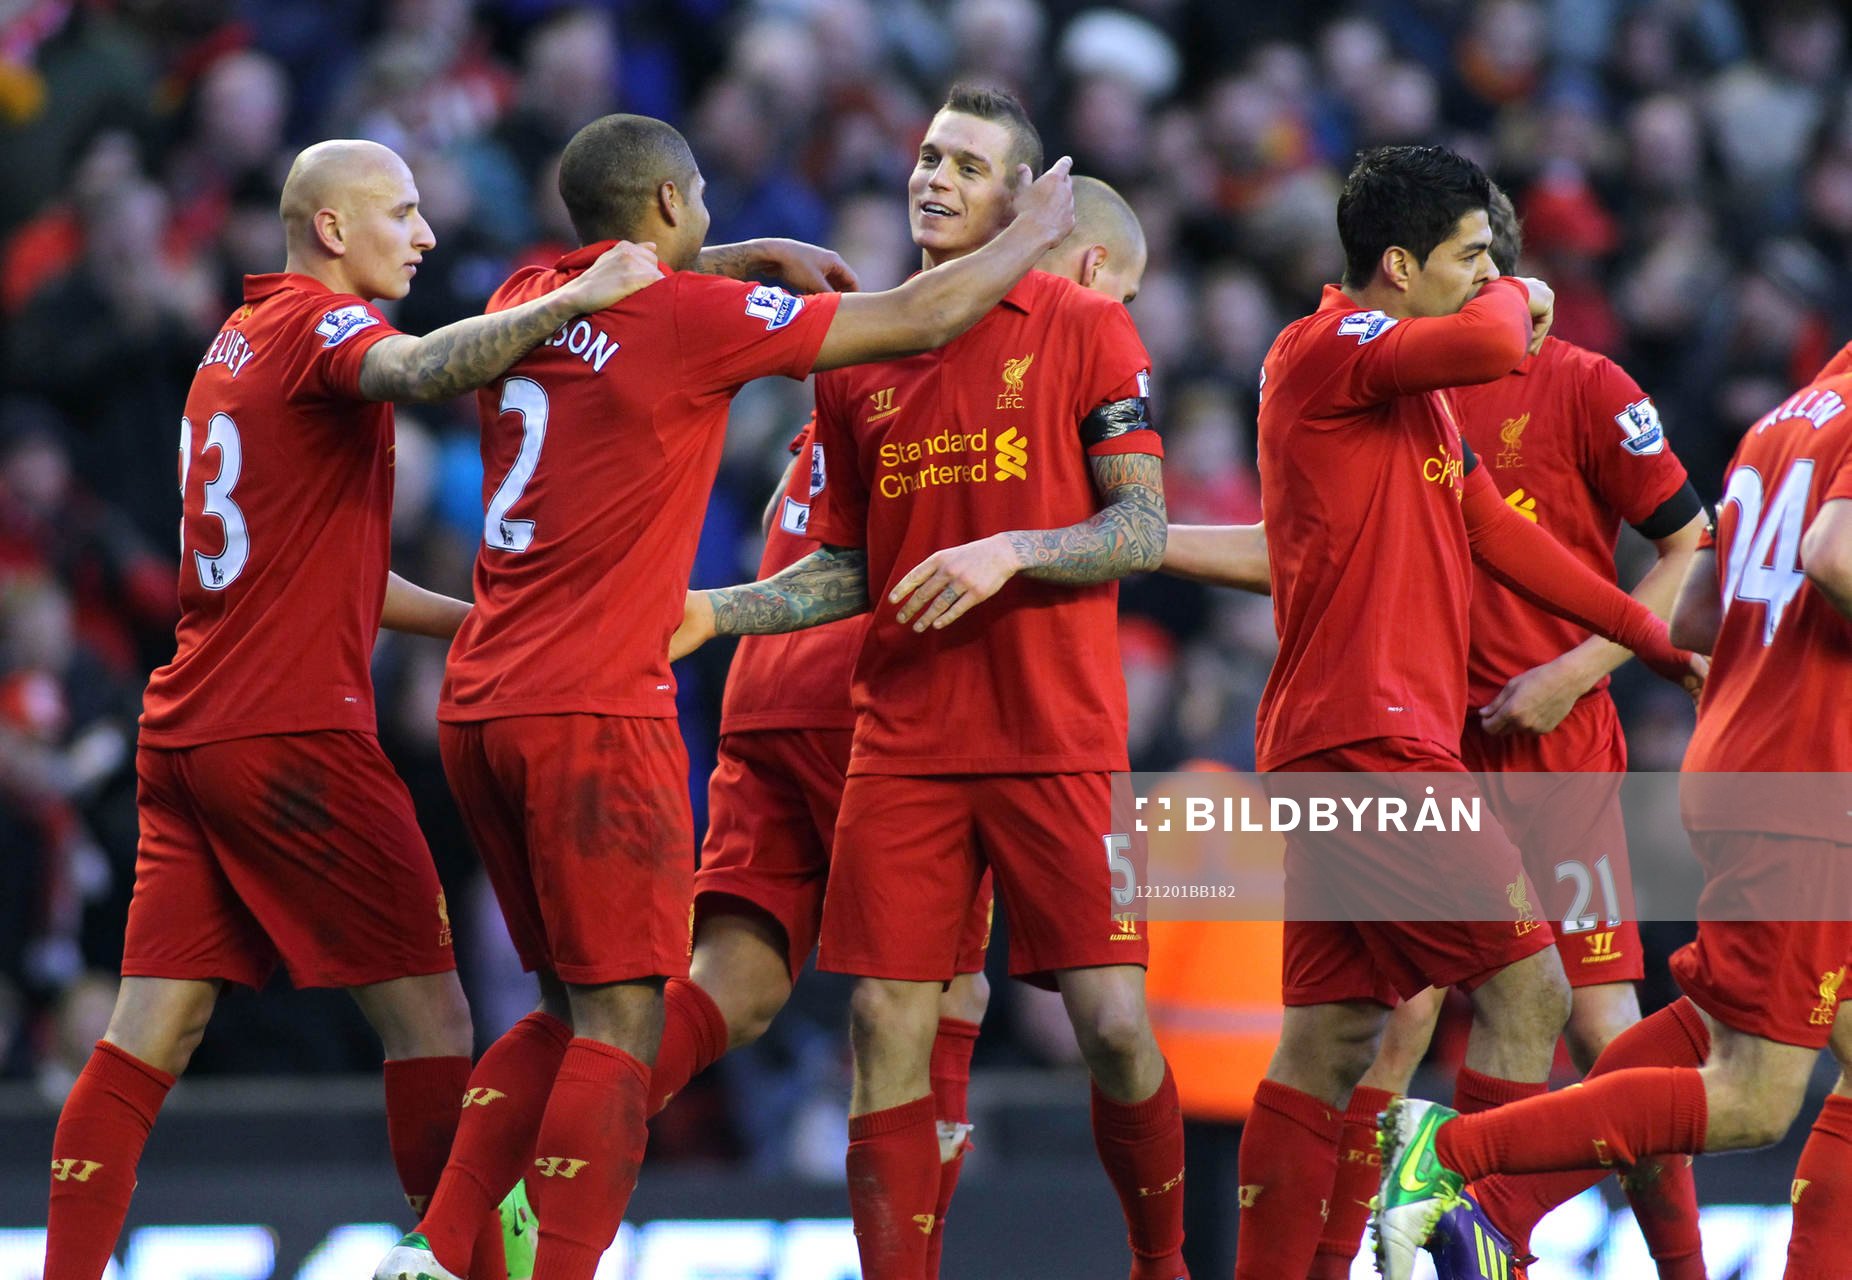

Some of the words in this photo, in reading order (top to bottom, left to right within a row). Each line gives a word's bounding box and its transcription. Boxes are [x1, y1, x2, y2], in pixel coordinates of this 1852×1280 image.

[197, 329, 254, 378] ELVEY
[545, 317, 621, 373] SON
[486, 376, 549, 552] 2
[879, 427, 987, 467] Standard
[879, 458, 987, 498] Chartered
[1722, 459, 1815, 646] 24
[1103, 833, 1136, 906] 5
[1553, 853, 1622, 934] 21
